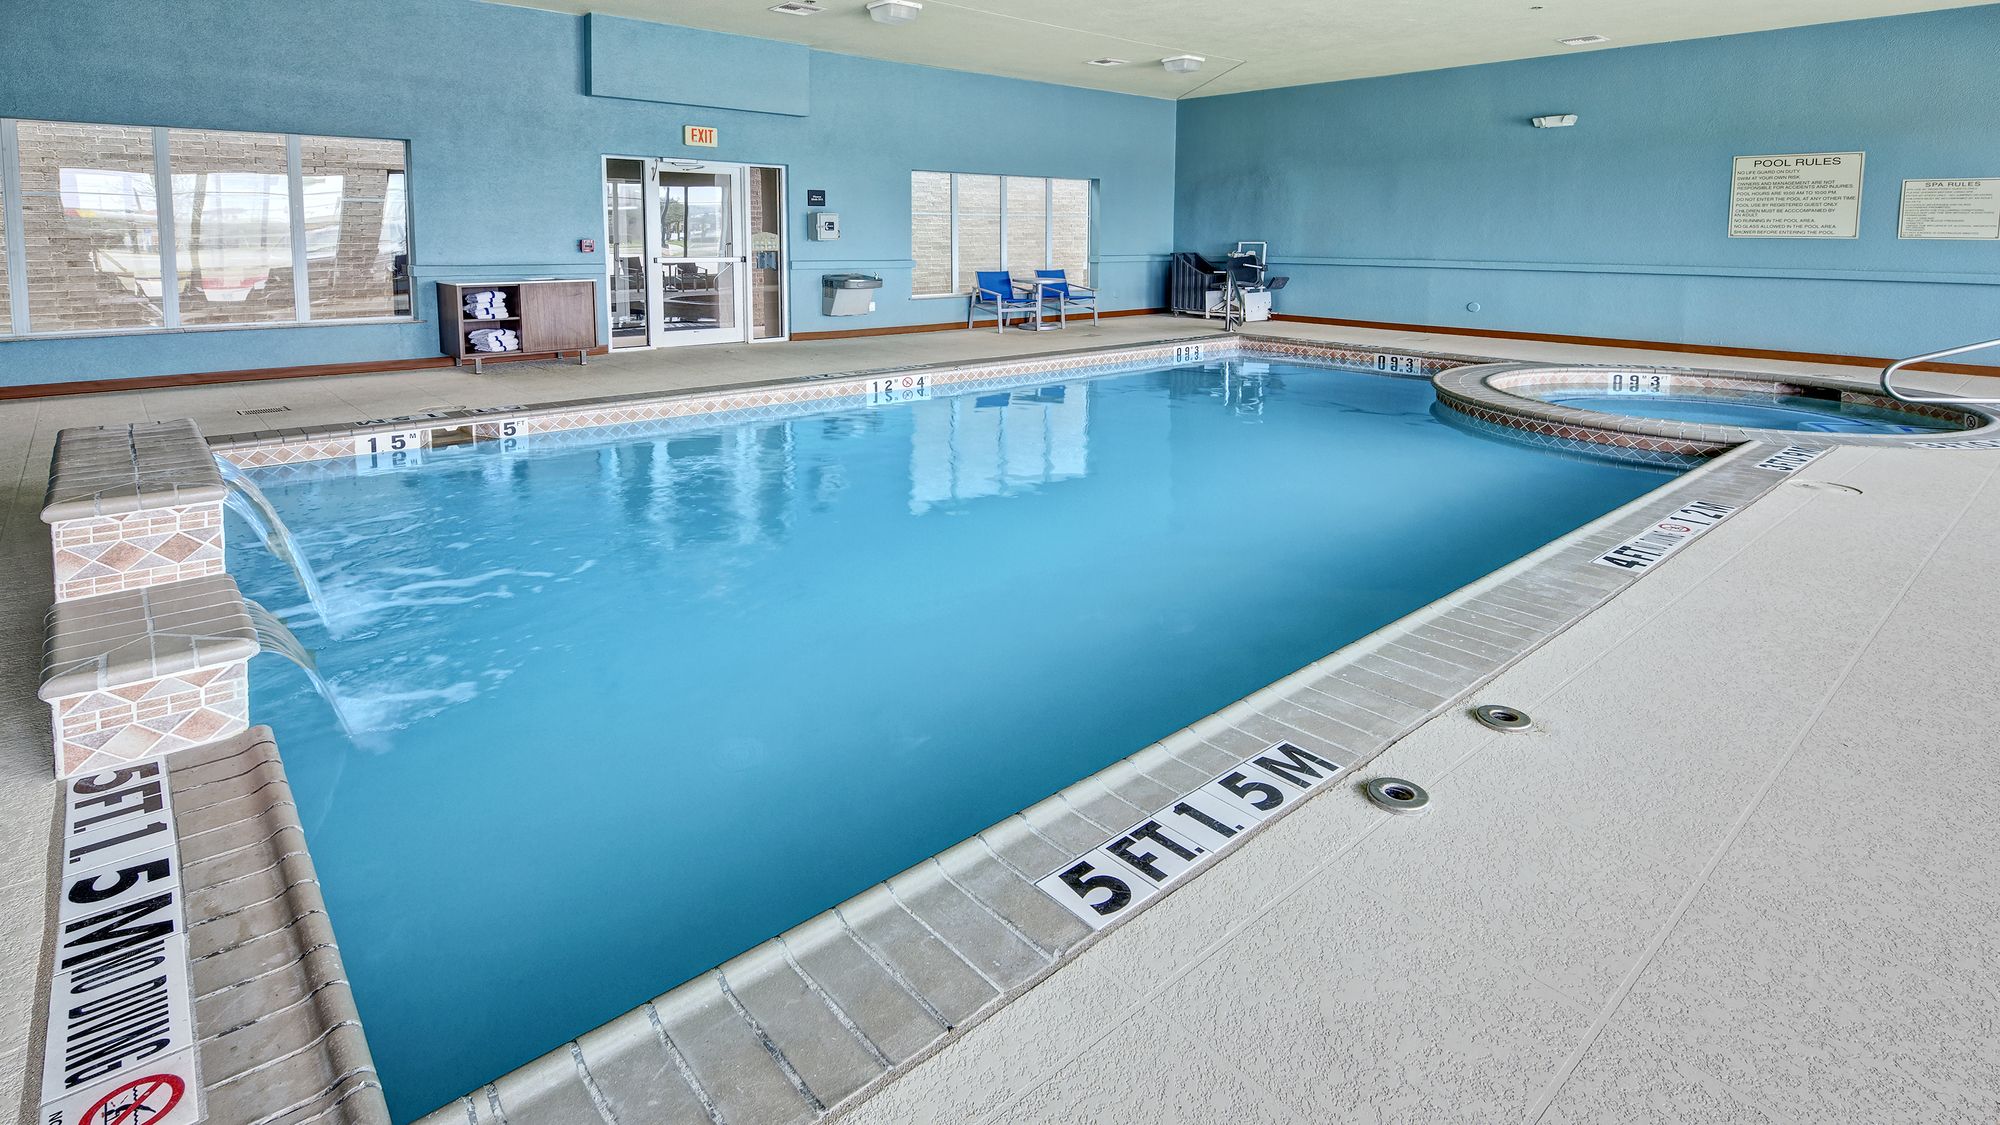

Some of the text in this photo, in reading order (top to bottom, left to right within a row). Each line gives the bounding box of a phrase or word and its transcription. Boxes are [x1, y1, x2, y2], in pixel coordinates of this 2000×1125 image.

[692, 128, 713, 143] EXIT
[1754, 157, 1841, 167] POOL RULES
[64, 974, 171, 1090] DIVING
